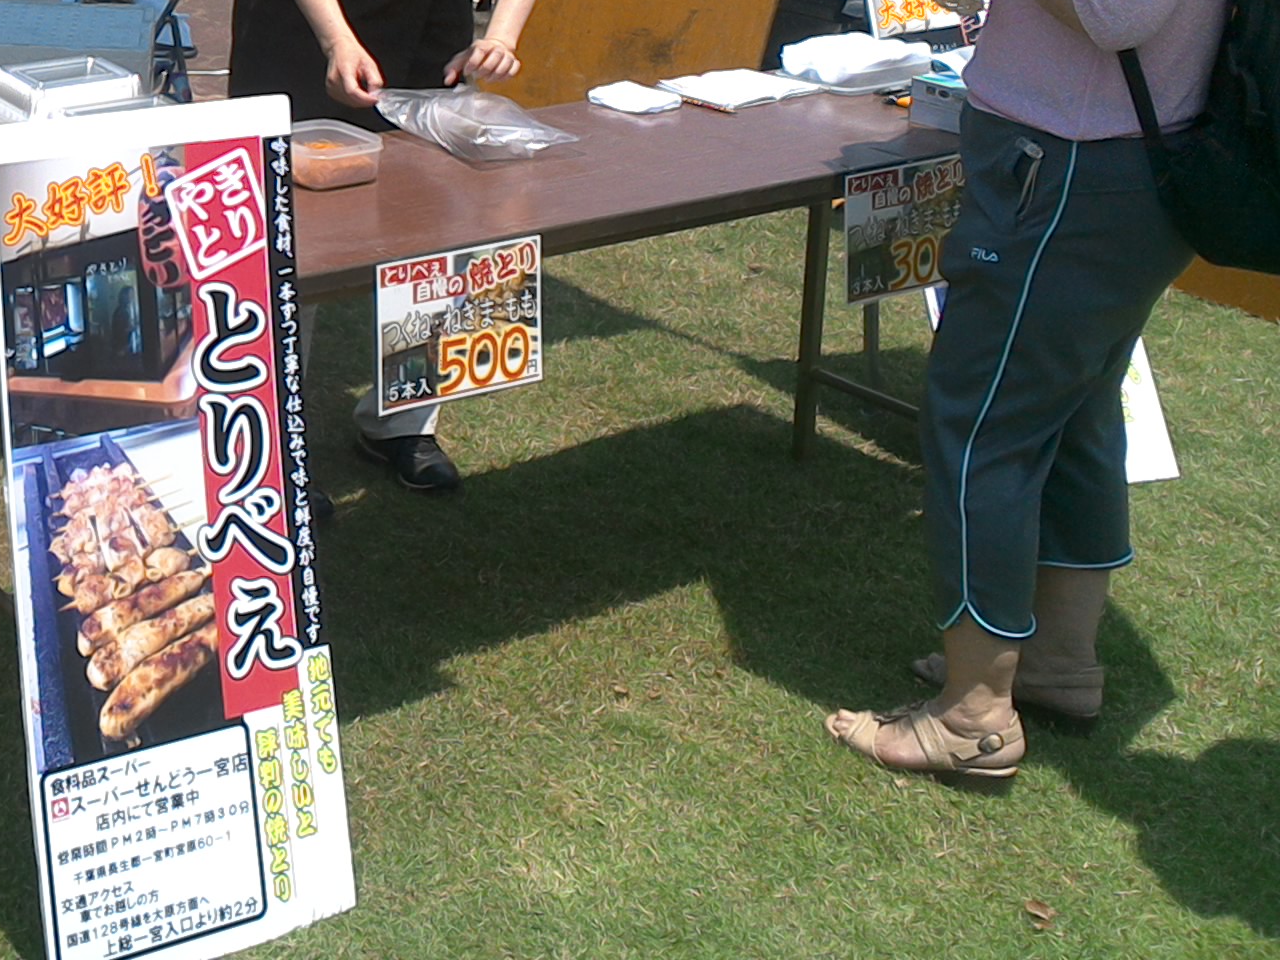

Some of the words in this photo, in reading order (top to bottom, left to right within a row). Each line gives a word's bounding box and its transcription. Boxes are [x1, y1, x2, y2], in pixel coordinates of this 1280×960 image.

[888, 234, 945, 291] 30
[971, 247, 1000, 263] FILA
[852, 275, 885, 296] 3本入
[388, 378, 433, 403] 5本入
[307, 651, 338, 775] 地元でも
[50, 758, 152, 797] 食料品スーパー
[281, 688, 318, 840] 美味しいと
[96, 789, 200, 832] 店内にて営業中
[61, 880, 135, 915] 交通アクセス
[80, 889, 160, 924] 車でお越しの方
